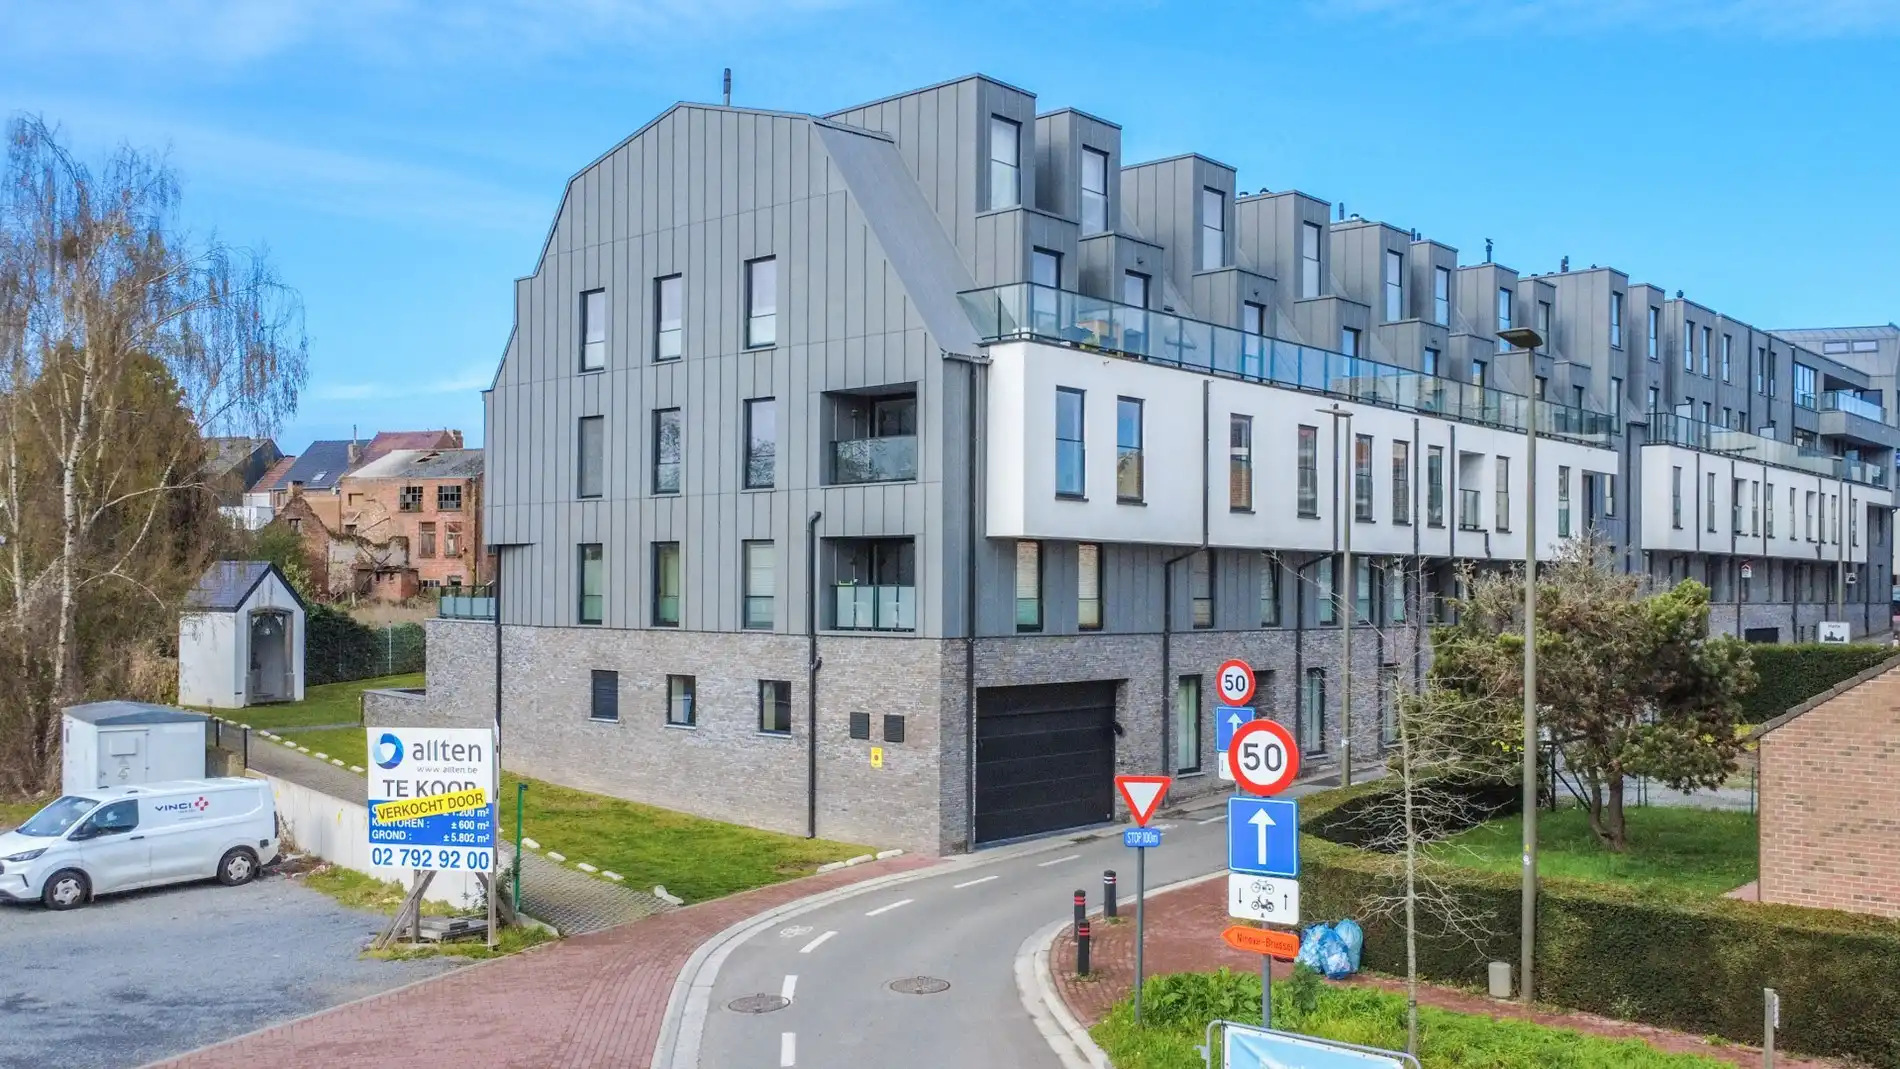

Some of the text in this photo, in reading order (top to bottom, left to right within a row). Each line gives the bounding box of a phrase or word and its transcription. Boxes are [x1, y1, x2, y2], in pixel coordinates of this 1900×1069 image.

[1225, 674, 1246, 692] 50
[413, 739, 482, 762] allten
[1243, 742, 1282, 772] 50
[383, 779, 409, 797] TE
[155, 802, 192, 811] VINCI
[378, 799, 444, 820] VERKOCHT
[448, 793, 484, 809] DOOR
[458, 820, 475, 830] 600
[372, 830, 406, 840] GROND
[1127, 831, 1142, 843] STOP
[372, 847, 490, 870] 02 792 92 00
